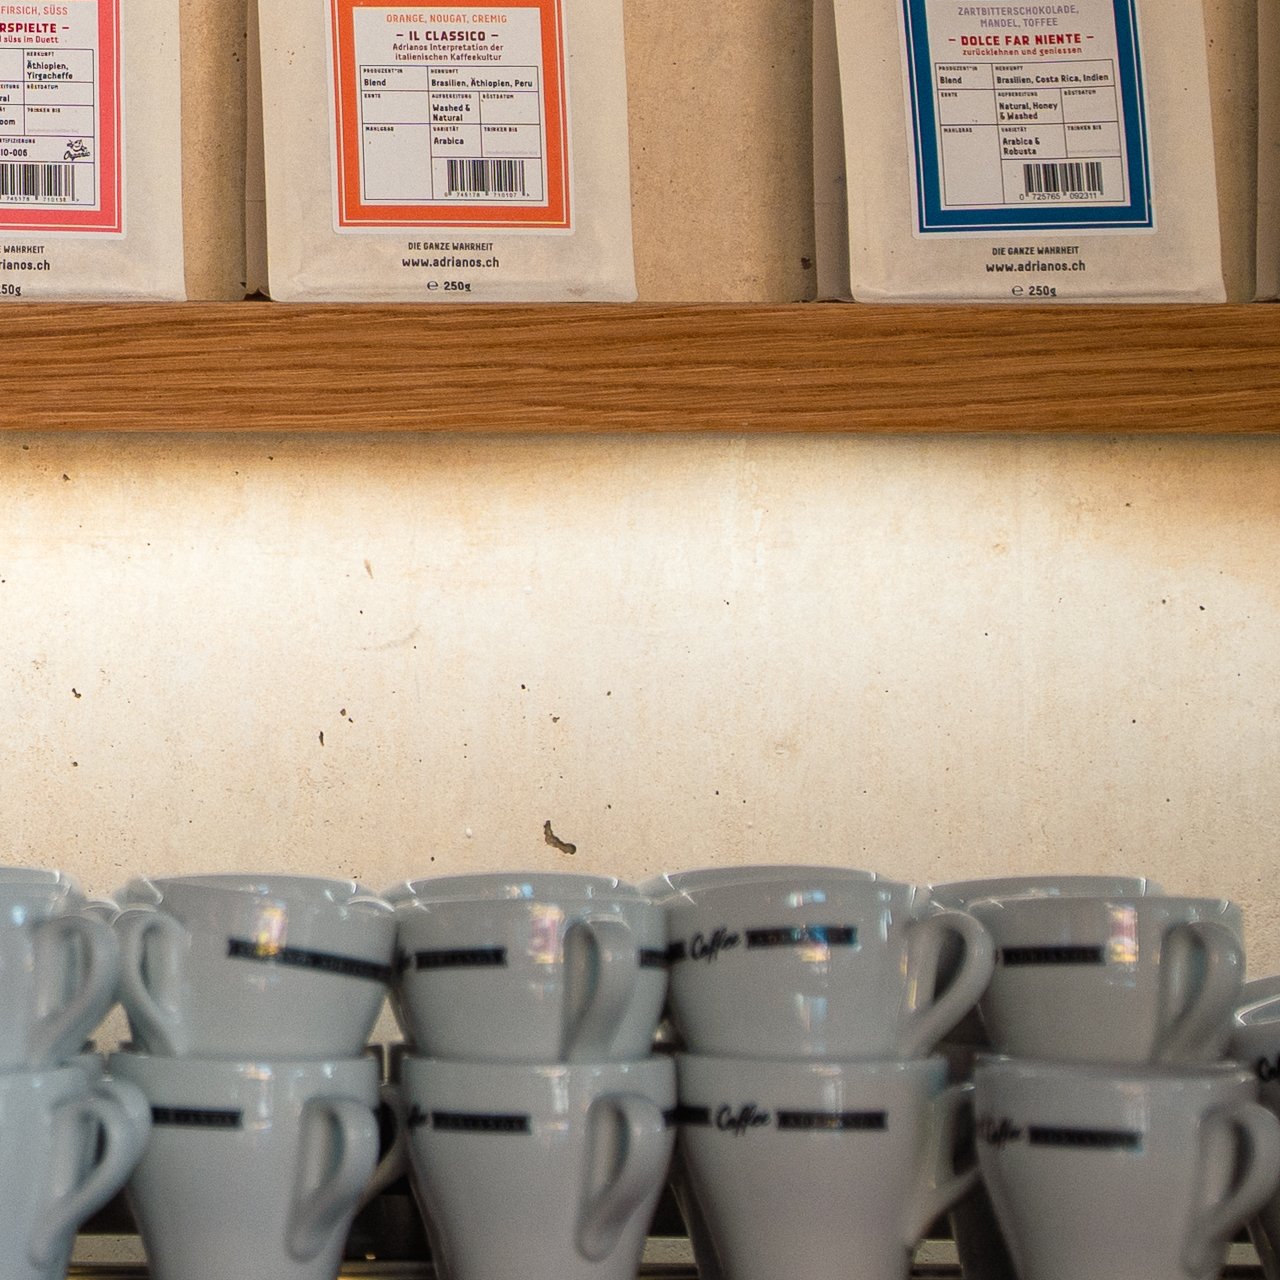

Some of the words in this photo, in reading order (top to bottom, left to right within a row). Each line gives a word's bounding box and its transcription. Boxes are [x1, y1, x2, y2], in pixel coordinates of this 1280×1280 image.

[43, 5, 68, 15] SÜSS
[958, 5, 1079, 16] ZARTBITTERSCHOKOLADE,
[387, 14, 427, 23] ORANGE,
[430, 15, 469, 24] NOUGAT,
[472, 15, 507, 23] CREMIG
[980, 19, 1020, 28] MANDEL,
[1023, 18, 1058, 27] TOFFEE
[409, 31, 420, 41] IL
[425, 31, 486, 41] CLASSICO
[961, 35, 1000, 46] DOLCE
[1005, 35, 1029, 45] FAR
[1035, 33, 1082, 44] NIENTE
[963, 48, 1019, 56] zurücklehnen
[1039, 47, 1082, 56] geniessen
[431, 79, 469, 88] Brasilien,
[471, 78, 512, 88] Äthiopien,
[3, 245, 44, 254] WAHRHEIT
[408, 242, 421, 250] DIE
[424, 242, 450, 250] GANZE
[452, 242, 493, 251] WAHRHEIT
[992, 247, 1005, 256] DIE
[1008, 247, 1034, 255] GANZE
[1037, 246, 1079, 255] WAHRHEIT
[402, 257, 499, 267] www.adrianos.ch
[986, 260, 1085, 272] www.adrianos.ch
[444, 281, 471, 292] 250g
[1029, 286, 1057, 297] 250g
